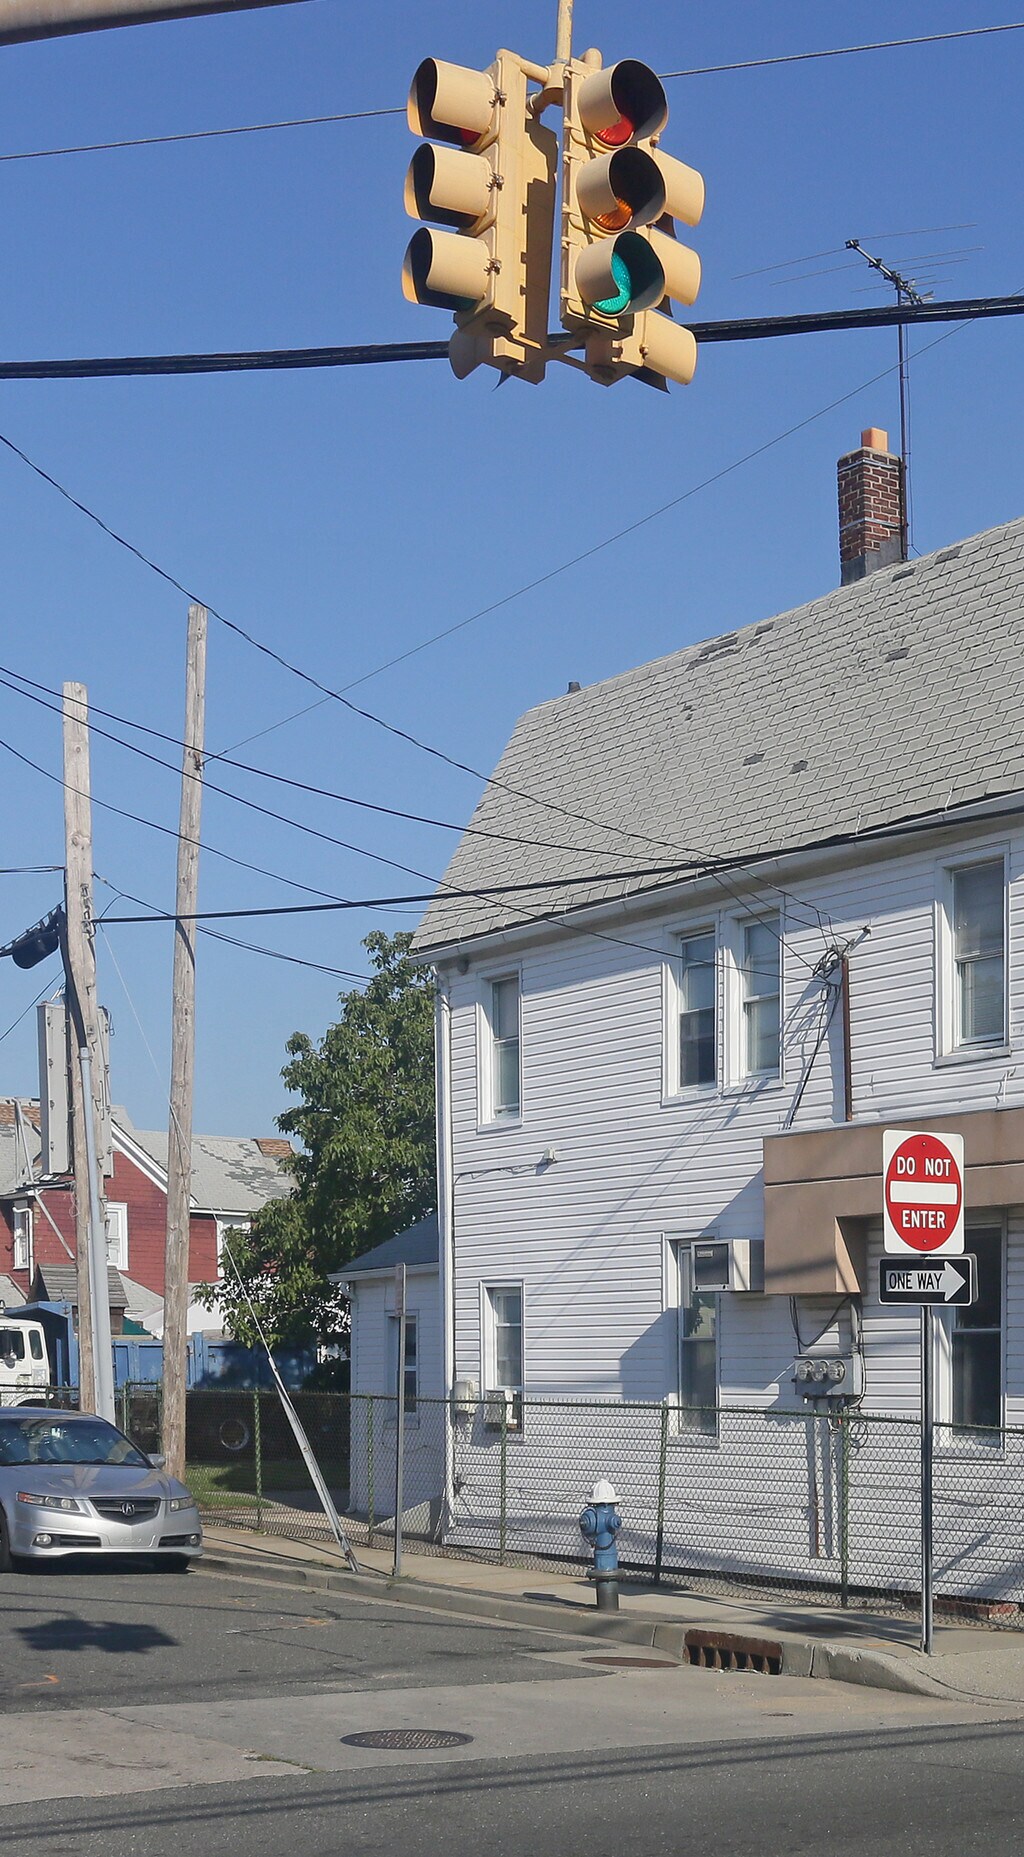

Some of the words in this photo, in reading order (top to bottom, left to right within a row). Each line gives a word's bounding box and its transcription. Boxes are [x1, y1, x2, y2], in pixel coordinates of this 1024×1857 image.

[896, 1156, 916, 1175] DO
[925, 1158, 951, 1177] NOT
[902, 1210, 946, 1229] ENTER
[889, 1272, 913, 1290] ONE
[917, 1272, 943, 1291] WAY
